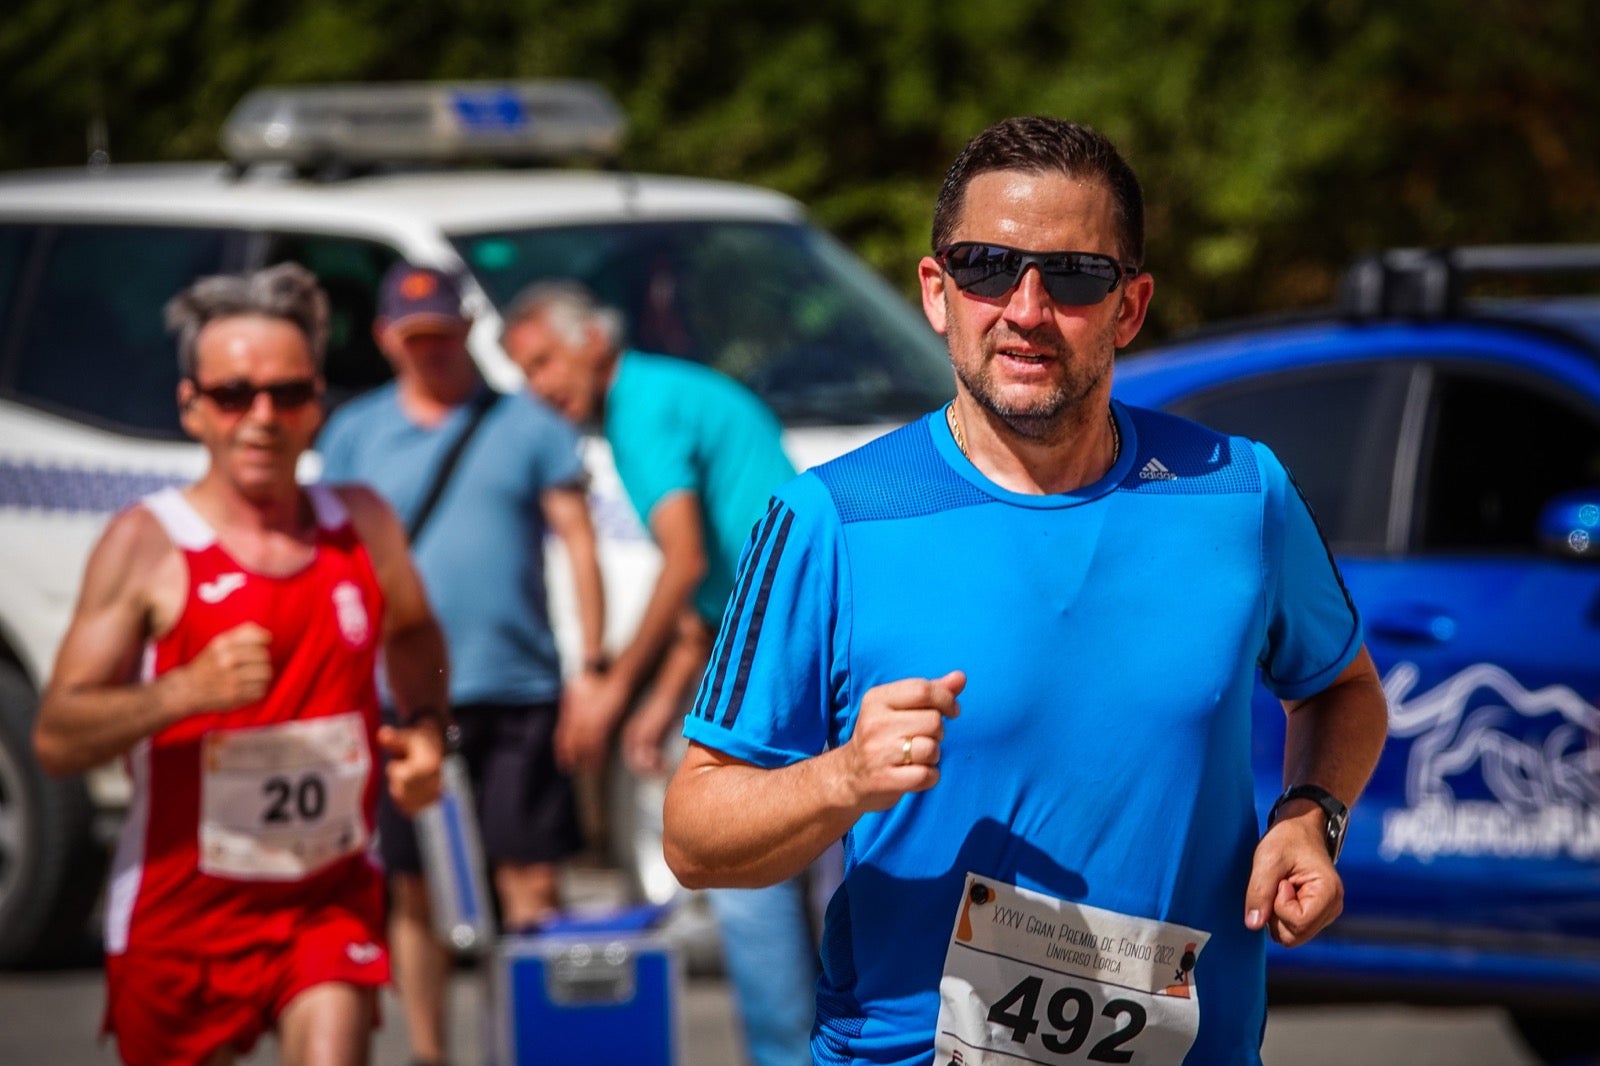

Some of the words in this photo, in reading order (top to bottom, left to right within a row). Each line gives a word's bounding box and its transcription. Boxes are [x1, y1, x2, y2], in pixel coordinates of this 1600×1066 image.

[1139, 471, 1177, 480] adidas
[263, 775, 325, 823] 20
[992, 905, 1025, 929] XXXV
[1026, 915, 1056, 939] GRAN
[1058, 923, 1098, 949] PREMIO
[1118, 938, 1152, 961] FONDO
[1154, 944, 1175, 966] 2022
[1046, 944, 1091, 967] UNIVERSO
[1093, 955, 1122, 974] LORCA
[987, 975, 1147, 1064] 492
